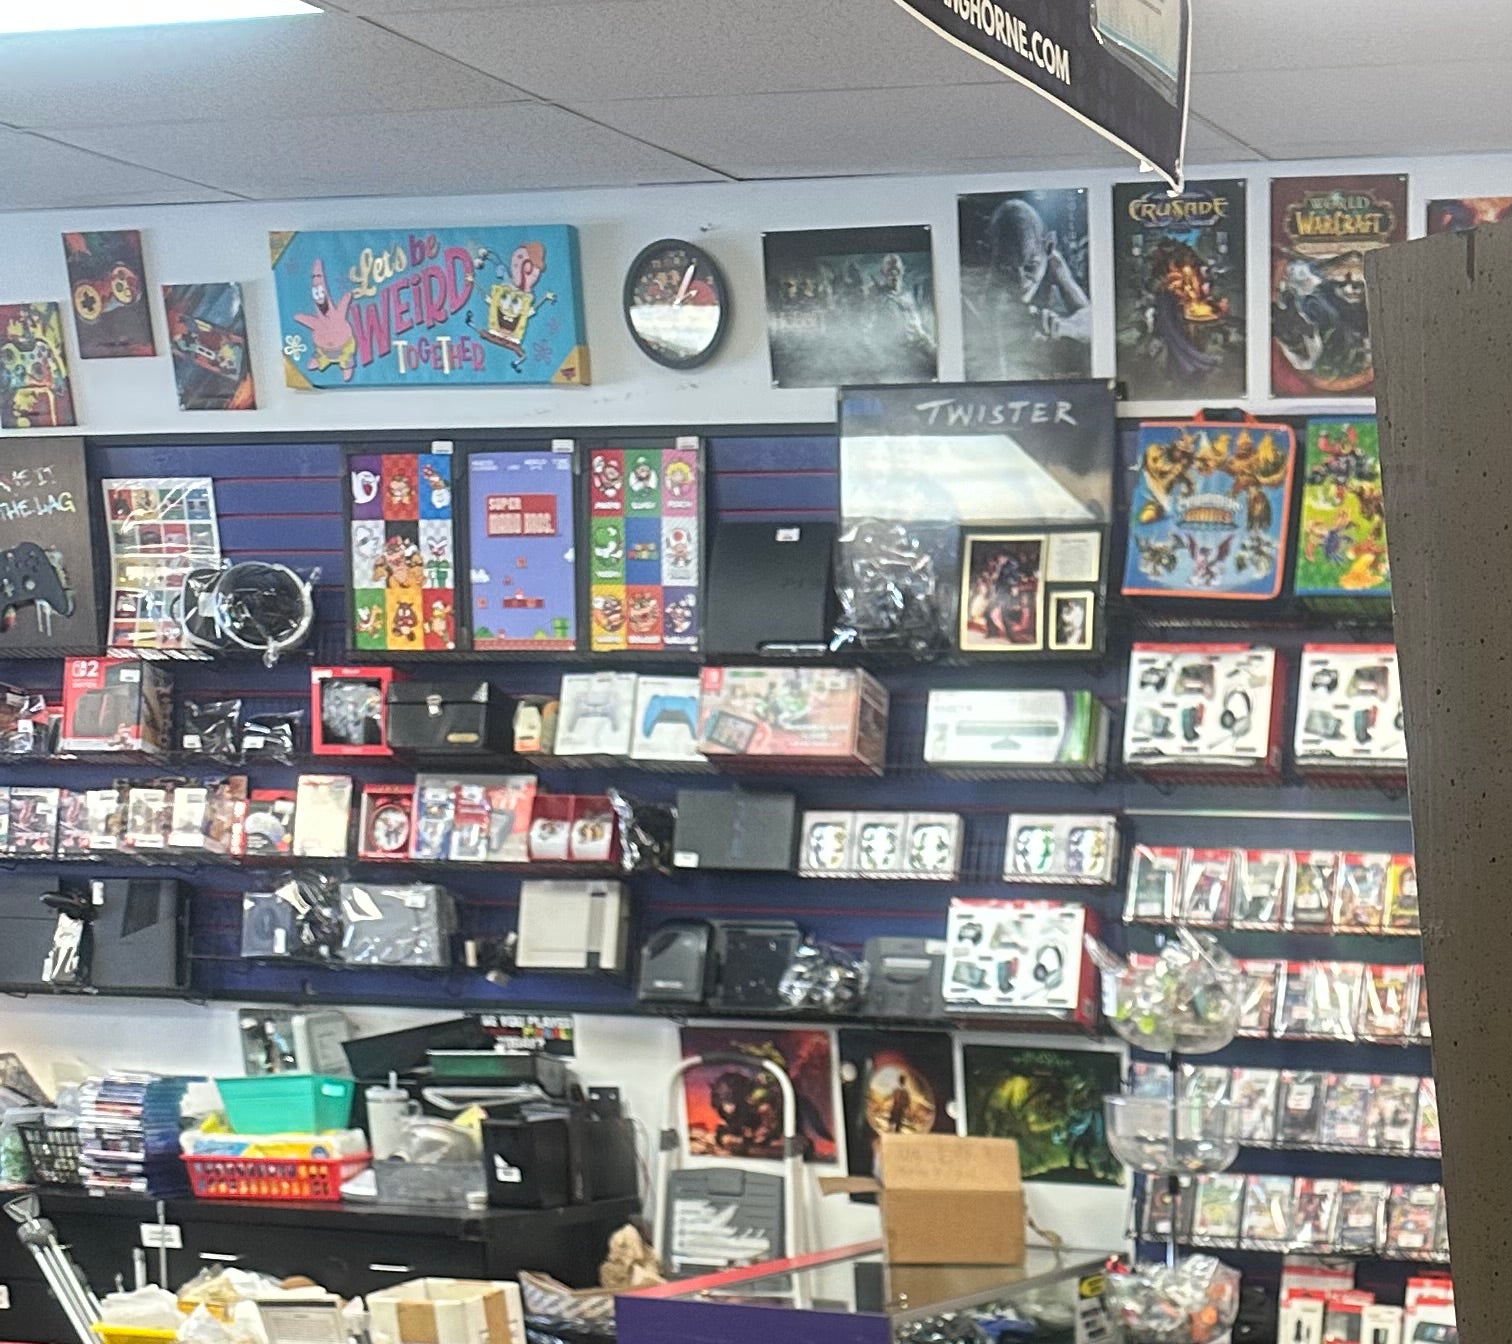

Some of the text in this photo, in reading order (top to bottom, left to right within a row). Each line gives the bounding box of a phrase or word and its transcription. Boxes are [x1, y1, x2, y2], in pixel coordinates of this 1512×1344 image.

[943, 0, 1071, 86] GHORNE.COM
[408, 233, 439, 267] be
[392, 336, 486, 374] TOGETHER
[915, 398, 1078, 426] TWISTER
[33, 491, 77, 516] LAG
